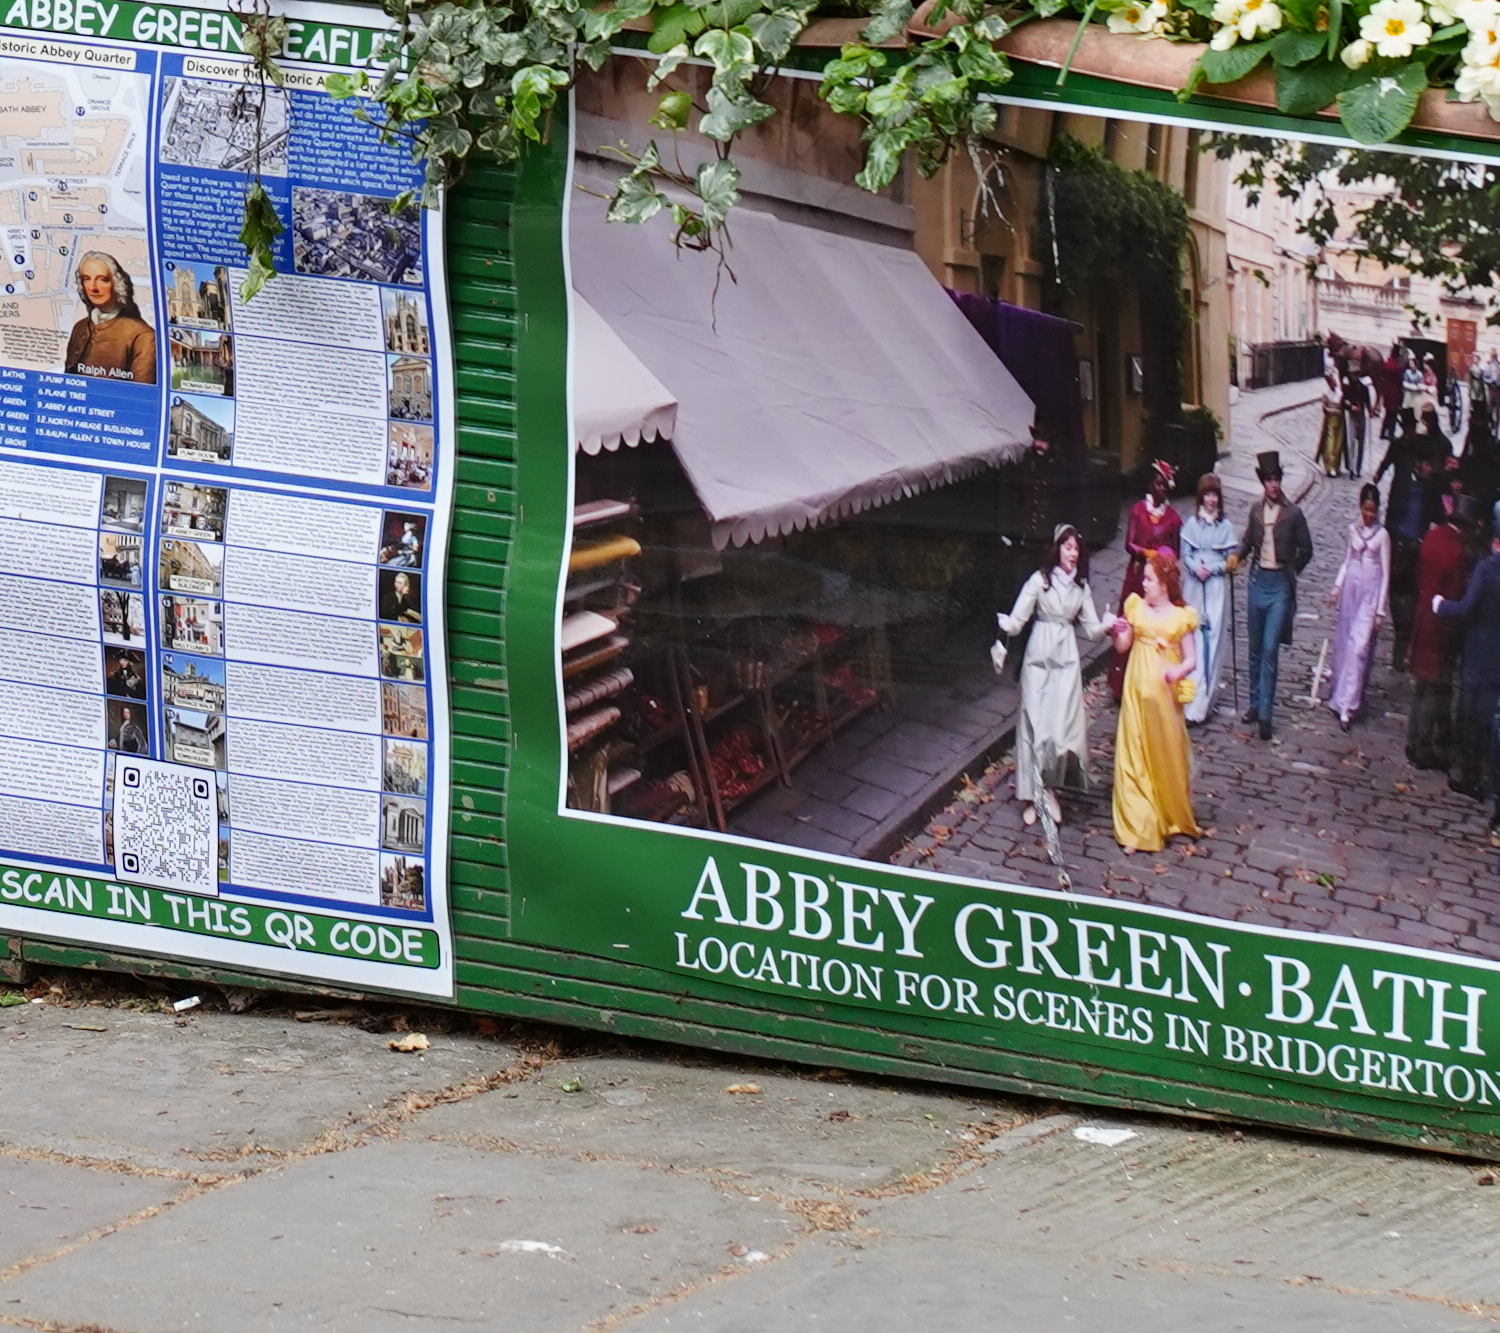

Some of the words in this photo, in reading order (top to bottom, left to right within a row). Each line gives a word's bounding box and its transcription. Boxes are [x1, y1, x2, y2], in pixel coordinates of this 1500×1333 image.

[40, 45, 80, 62] Abbey
[84, 49, 132, 66] Quarter
[272, 23, 409, 70] EAFLET
[78, 363, 106, 377] Ralph
[109, 366, 133, 379] Allen
[1, 870, 93, 913] SCAN
[107, 884, 151, 919] IN
[163, 893, 251, 933] THIS
[265, 911, 315, 950] QR
[330, 922, 423, 962] CODE
[682, 855, 934, 959] ABBEY
[674, 931, 883, 1002] LOCATION
[897, 971, 984, 1017] FOR
[993, 984, 1155, 1046] SCENES
[1165, 1013, 1209, 1056] IN
